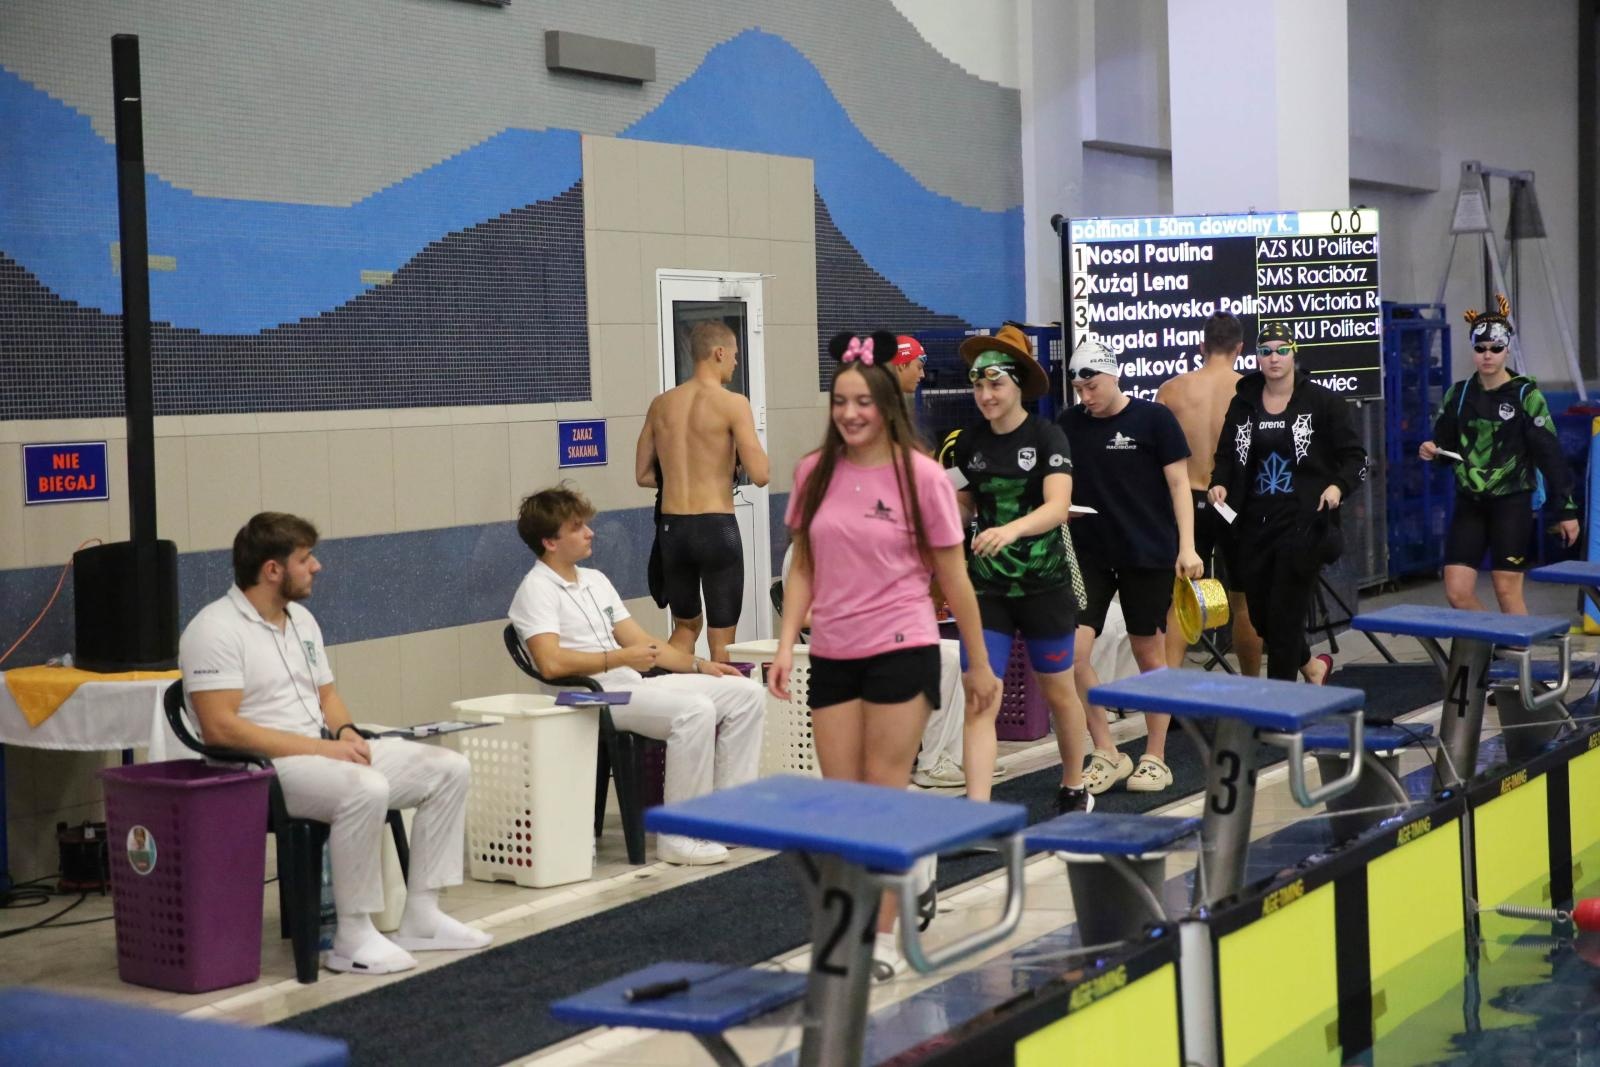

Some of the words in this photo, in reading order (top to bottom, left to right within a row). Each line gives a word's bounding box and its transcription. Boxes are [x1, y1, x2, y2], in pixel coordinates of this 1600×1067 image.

[1158, 217, 1196, 238] 50m
[1199, 213, 1273, 235] dowolny
[1277, 213, 1293, 232] K.
[1075, 247, 1083, 272] 1
[1087, 244, 1139, 265] Nosol
[1145, 241, 1213, 263] Paulina
[1257, 239, 1287, 259] AZS
[1292, 238, 1313, 258] KU
[1074, 276, 1087, 300] 2
[1088, 272, 1138, 297] Kużaj
[1144, 272, 1189, 292] Lena
[1258, 267, 1293, 287] SMS
[1298, 264, 1368, 285] Racibórz
[1075, 305, 1088, 328] 3
[1089, 299, 1214, 323] Malakhovska
[1258, 295, 1294, 314] SMS
[1298, 292, 1361, 312] Victoria
[1295, 320, 1316, 340] KU
[572, 427, 593, 442] ZAKAZ
[1259, 420, 1286, 430] arena
[53, 453, 80, 470] NIE
[567, 444, 599, 459] SKAKANIA
[38, 474, 96, 493] BIEGAJ
[1448, 665, 1470, 718] 4
[1211, 750, 1241, 815] 3
[816, 886, 854, 978] 2
